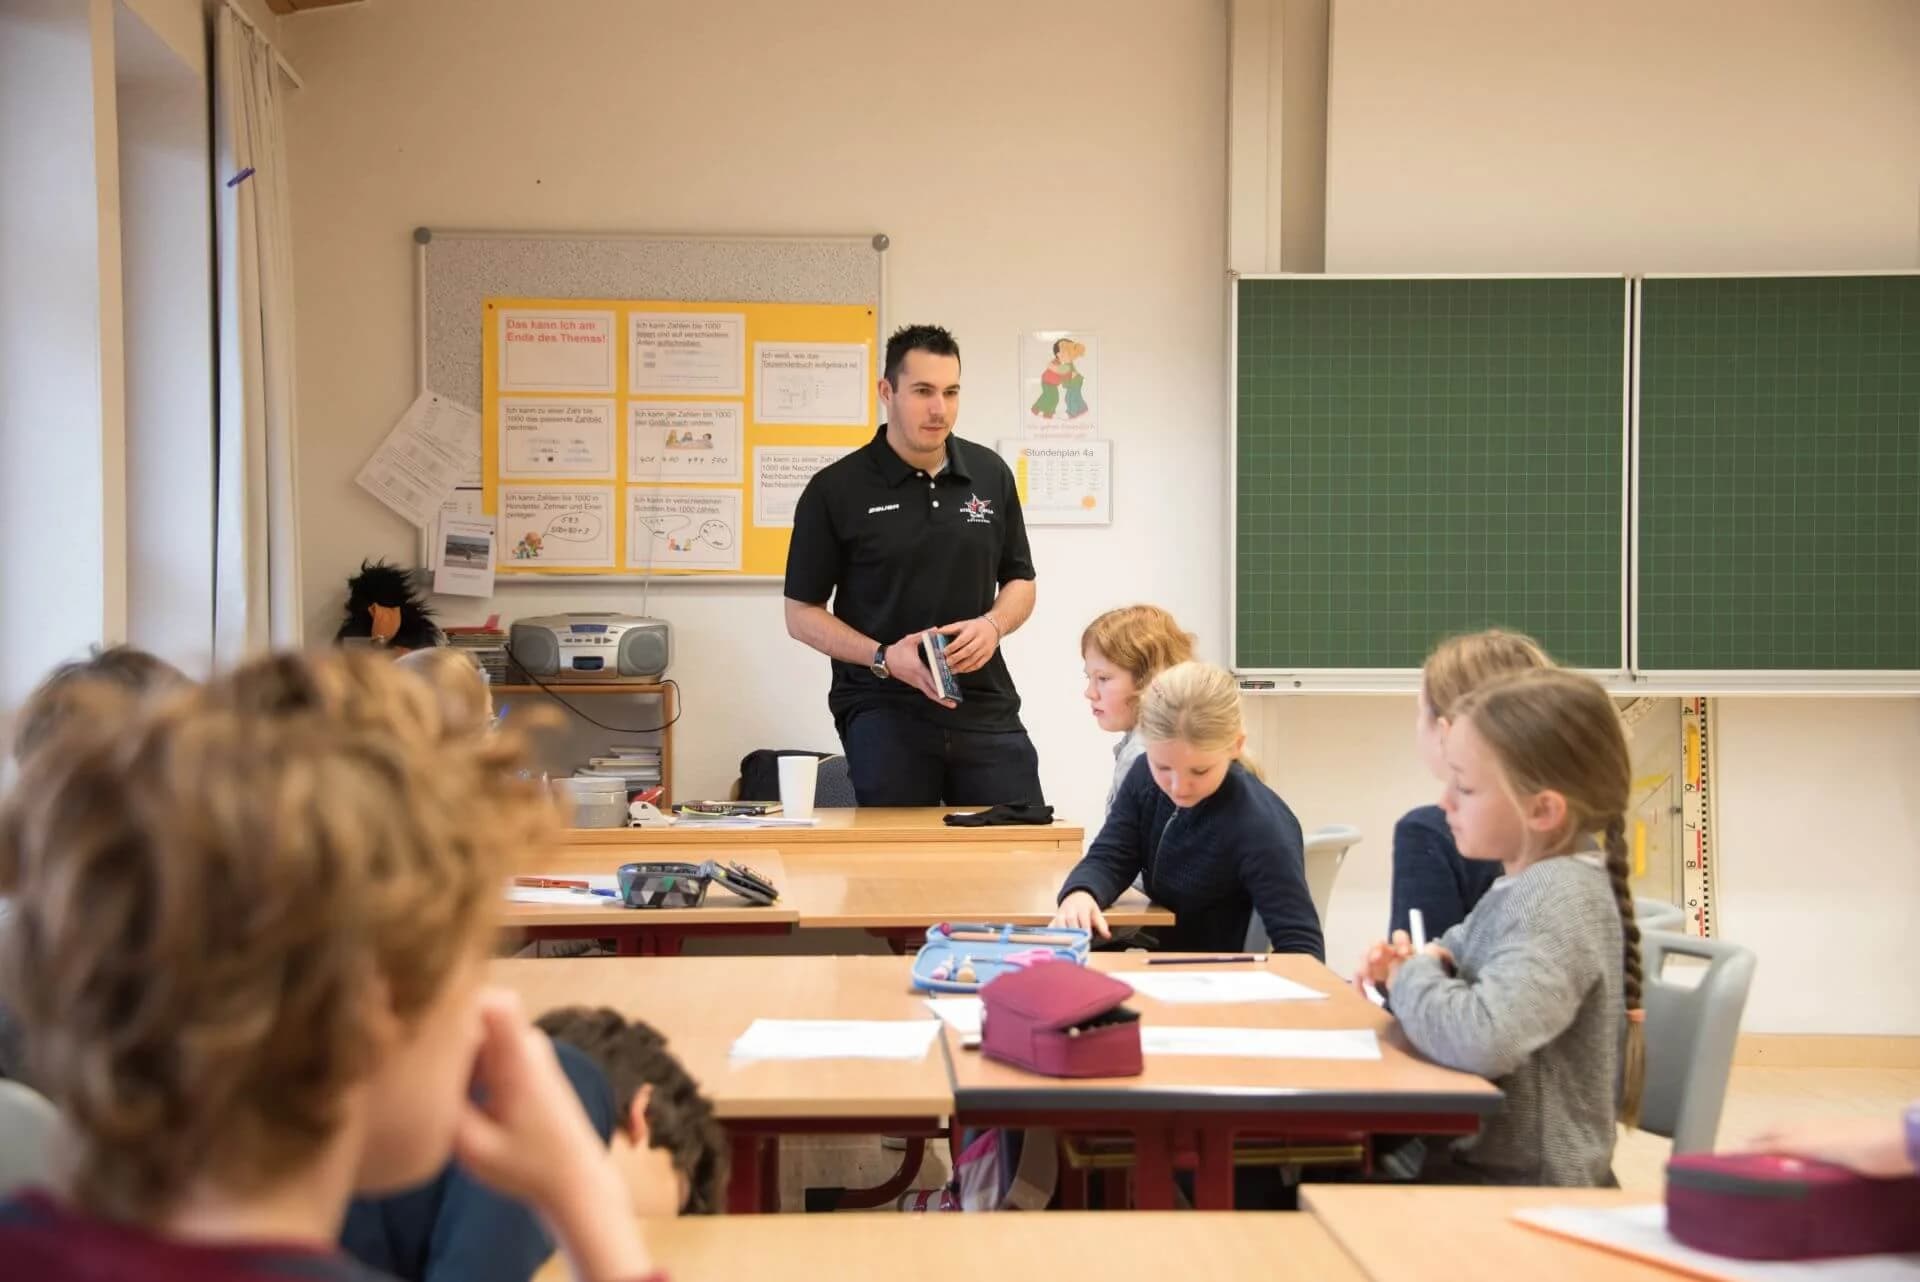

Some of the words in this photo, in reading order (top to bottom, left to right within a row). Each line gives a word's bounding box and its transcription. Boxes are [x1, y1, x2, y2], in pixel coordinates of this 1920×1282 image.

[507, 320, 528, 329] Das
[531, 320, 557, 329] kann
[636, 320, 647, 328] Ich
[649, 320, 666, 329] kann
[668, 320, 690, 329] Zahlen
[692, 320, 702, 329] bis
[705, 320, 721, 329] 1000
[507, 332, 535, 342] Ende
[538, 333, 557, 342] des
[561, 334, 606, 343] Themas!
[1026, 448, 1081, 458] Stundenplan
[1082, 448, 1094, 458] 4a
[1684, 706, 1694, 715] 4
[1684, 783, 1696, 792] 6
[1686, 822, 1696, 830] 7
[1686, 860, 1696, 868] 8
